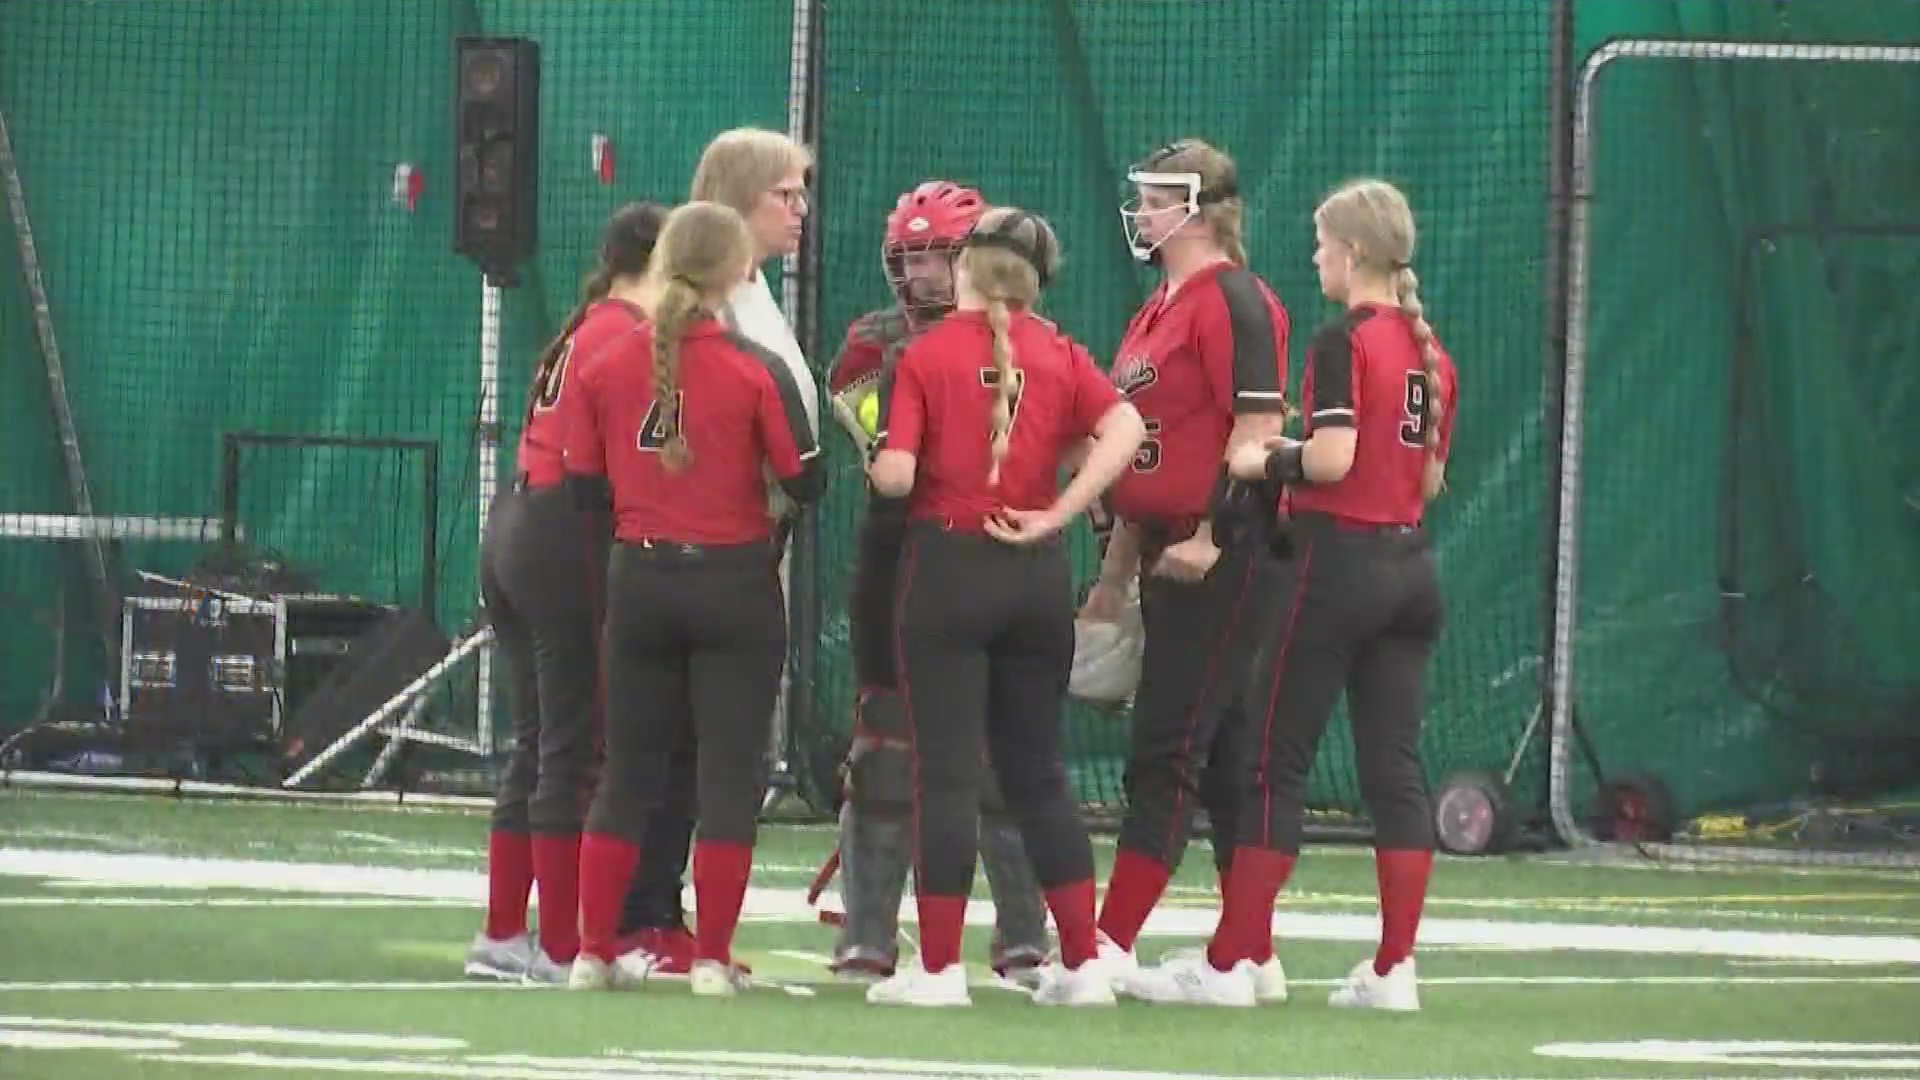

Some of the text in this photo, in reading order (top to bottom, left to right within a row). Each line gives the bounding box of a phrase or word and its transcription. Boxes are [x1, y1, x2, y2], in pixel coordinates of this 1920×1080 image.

[636, 389, 687, 452] 4
[979, 366, 1025, 444] 7
[1399, 368, 1430, 448] 9
